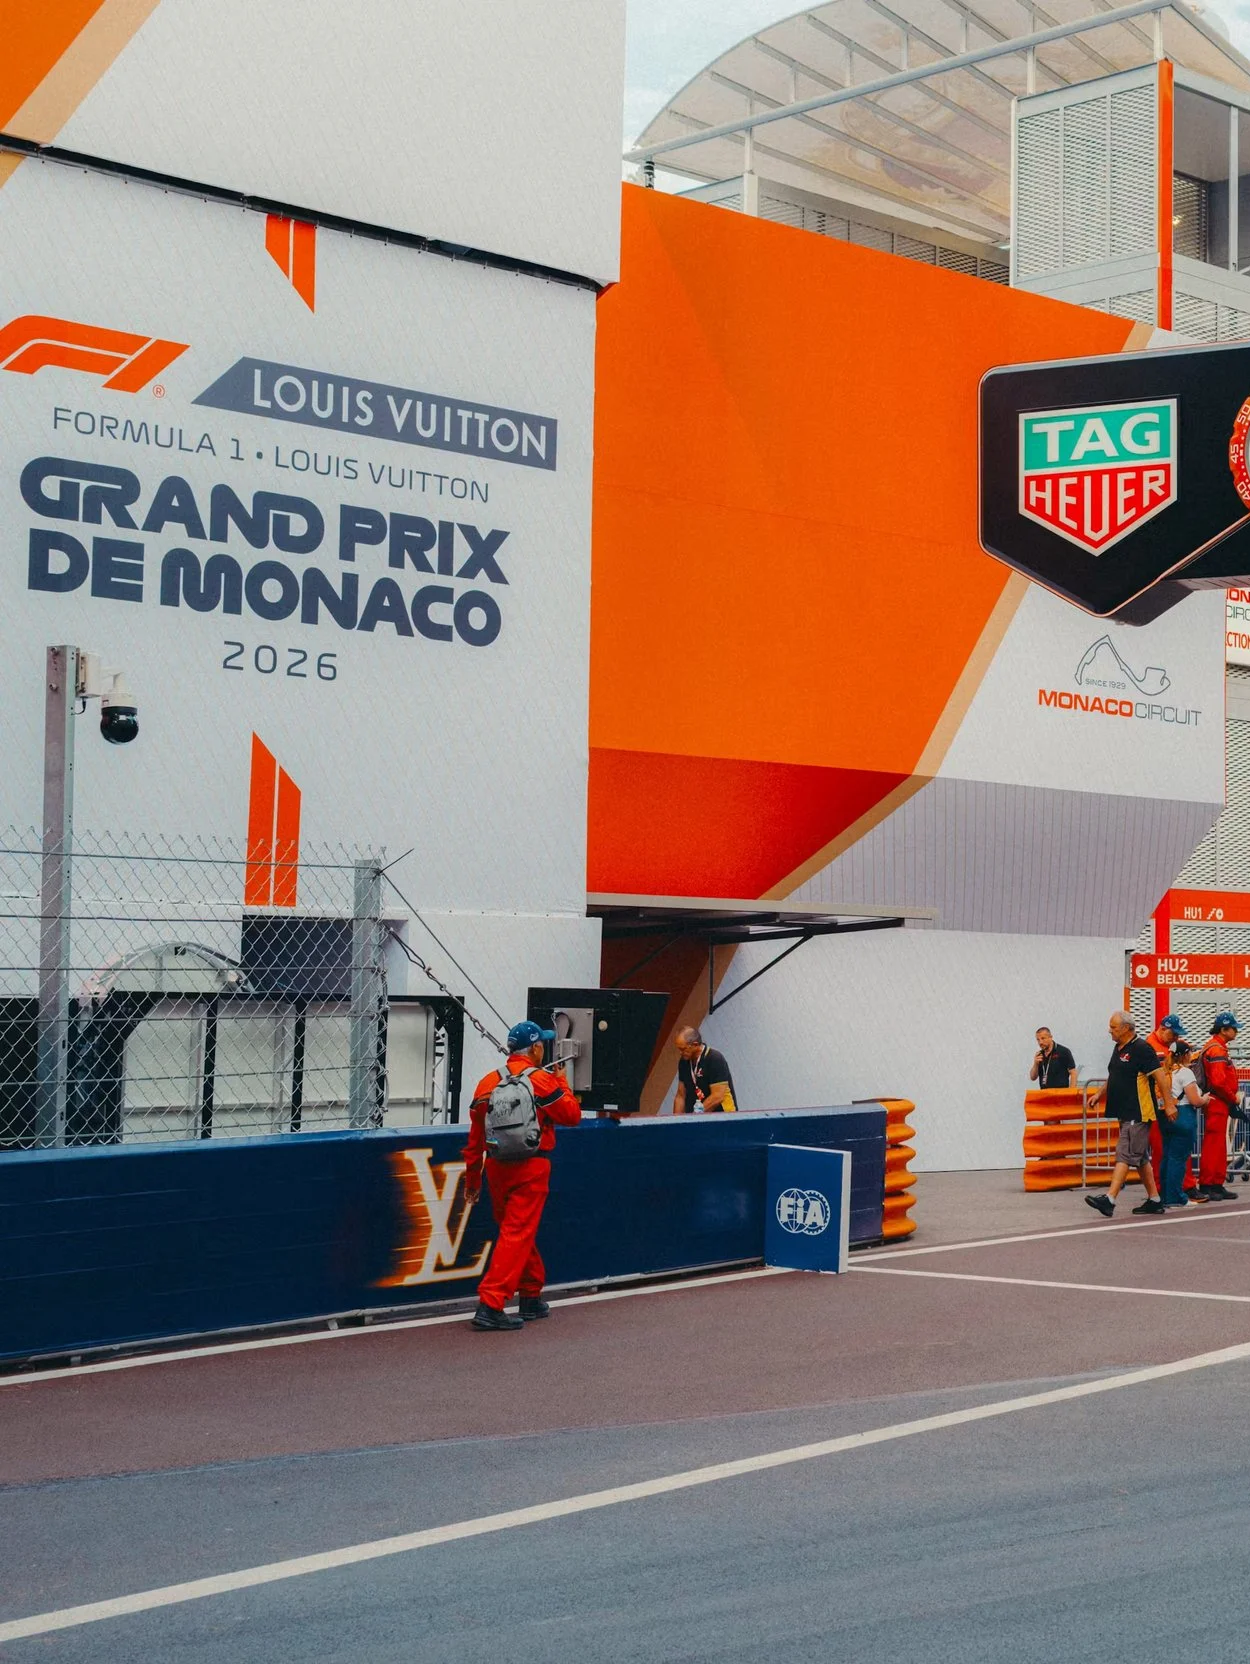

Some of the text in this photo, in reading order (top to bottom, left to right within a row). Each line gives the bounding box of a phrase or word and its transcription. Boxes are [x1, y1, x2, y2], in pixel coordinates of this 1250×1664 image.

[252, 369, 548, 460] LOUIS VUITTON
[1032, 411, 1161, 462] TAG
[1237, 404, 1250, 424] 50
[53, 407, 489, 503] FORMULA 1 LOUIS VUITTON
[19, 456, 511, 586] GRAND PRIX
[1029, 468, 1166, 542] HEUER
[28, 528, 502, 647] DE MONACO
[222, 640, 338, 681] 2026
[1085, 678, 1126, 690] SINCE 1929
[1184, 907, 1202, 920] HU1
[1157, 959, 1188, 972] HU2
[1157, 974, 1225, 985] BELVEDERE
